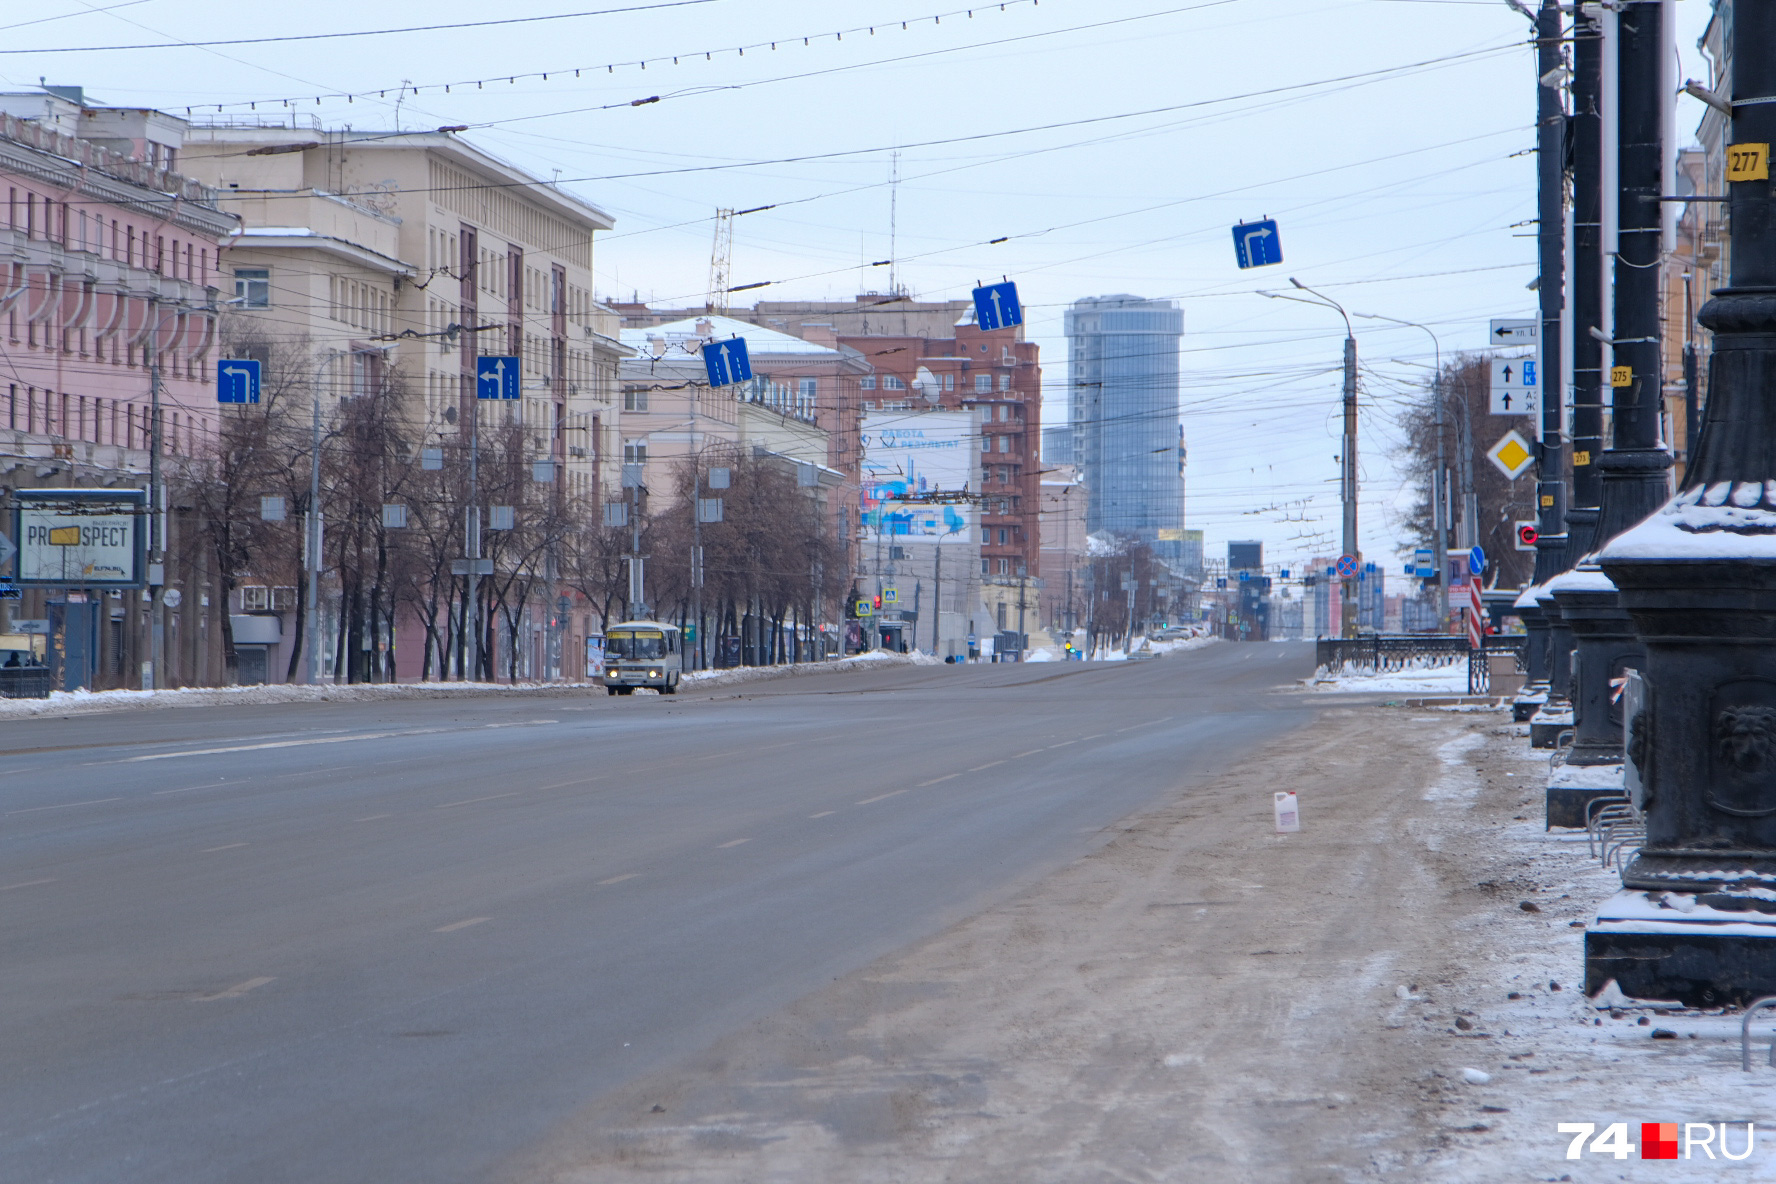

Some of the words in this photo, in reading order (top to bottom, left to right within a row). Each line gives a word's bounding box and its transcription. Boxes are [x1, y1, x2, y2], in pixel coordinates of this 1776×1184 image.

[1733, 152, 1760, 172] 277
[1613, 371, 1627, 382] 275
[882, 430, 924, 438] РАБОТА
[902, 440, 959, 448] РЕЗУЛЬТАТ
[1575, 455, 1586, 463] 273
